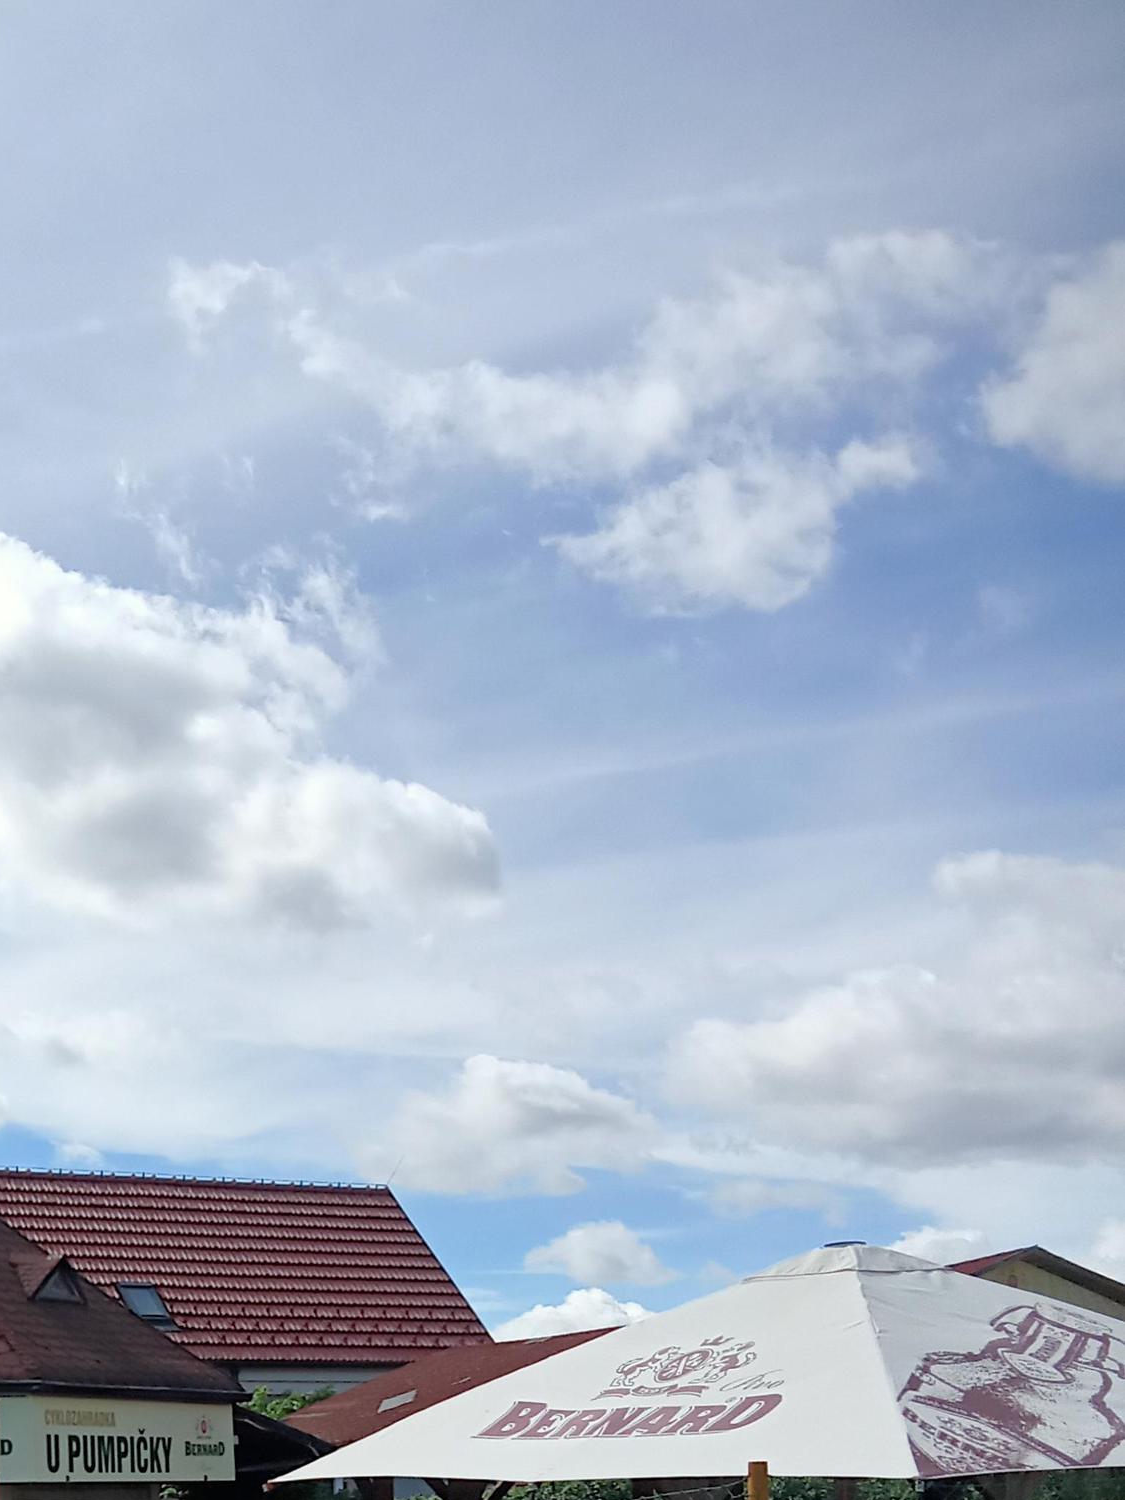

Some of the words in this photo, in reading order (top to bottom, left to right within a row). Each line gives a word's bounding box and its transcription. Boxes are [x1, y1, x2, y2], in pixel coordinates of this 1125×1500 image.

[470, 1394, 782, 1440] BERNARD
[46, 1434, 60, 1473] U
[68, 1428, 172, 1473] PUMPIČKY
[185, 1441, 225, 1456] BERNARD
